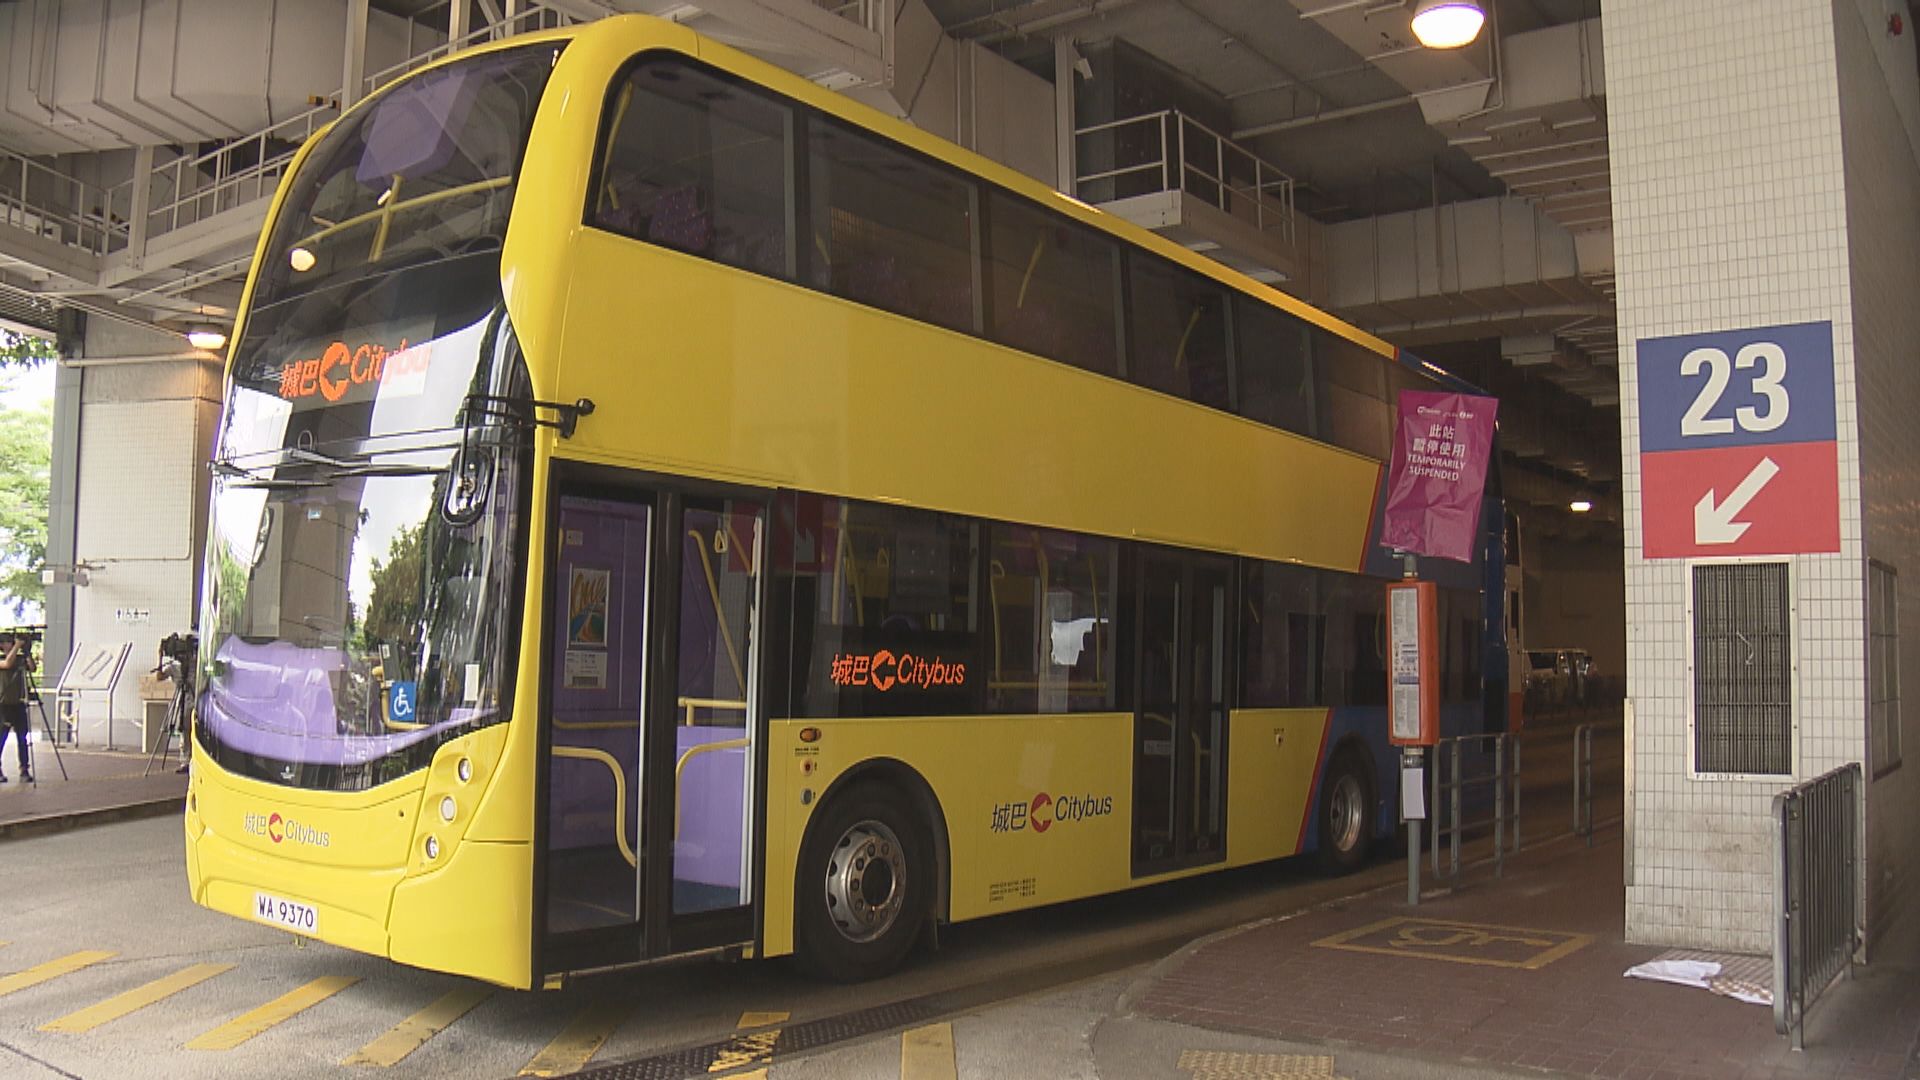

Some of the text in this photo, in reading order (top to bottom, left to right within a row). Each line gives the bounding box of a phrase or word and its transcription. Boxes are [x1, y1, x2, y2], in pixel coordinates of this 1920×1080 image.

[278, 359, 320, 398] 城巴
[1681, 342, 1790, 436] 23
[1429, 423, 1455, 440] 此站
[1408, 453, 1466, 470] TEMPORARILY
[1409, 465, 1459, 481] SUSPENDED
[830, 653, 966, 689] 城巴 Citybus
[244, 811, 330, 847] 城巴 Citybus
[990, 793, 1113, 832] 城巴 Citybus
[258, 895, 314, 927] WA 9370
